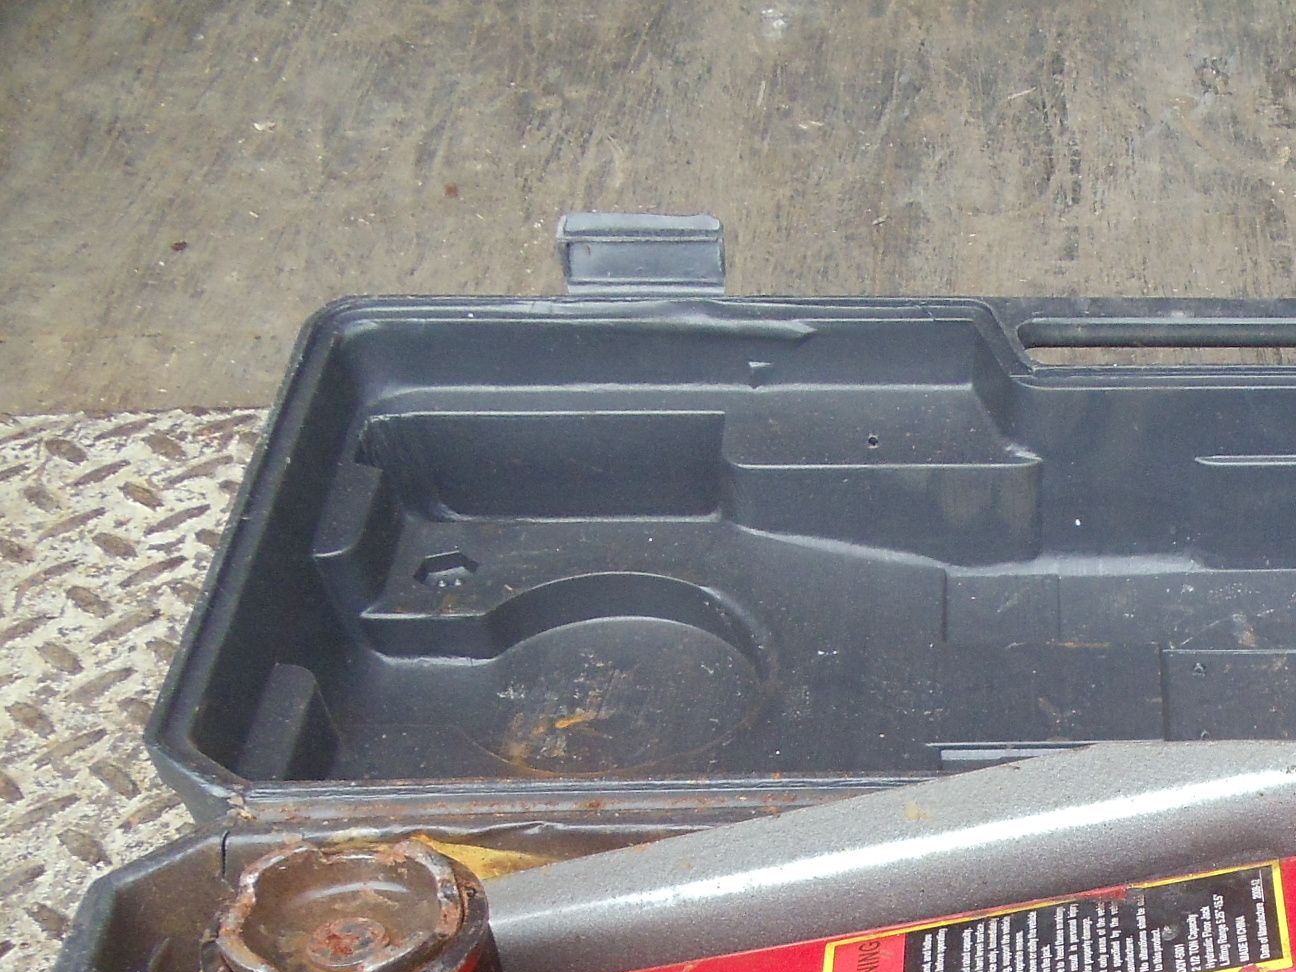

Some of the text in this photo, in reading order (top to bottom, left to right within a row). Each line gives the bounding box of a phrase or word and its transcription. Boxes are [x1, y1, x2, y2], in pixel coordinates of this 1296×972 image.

[1067, 902, 1078, 917] injury
[1136, 907, 1145, 915] be
[1028, 910, 1036, 928] vehicle
[1096, 917, 1105, 927] the
[1110, 917, 1118, 927] the
[1137, 915, 1146, 929] shall
[1186, 913, 1199, 939] Capacity
[1254, 902, 1267, 936] Manufacture
[1028, 928, 1036, 938] the
[1055, 929, 1063, 945] these
[1068, 918, 1079, 943] personal
[1097, 927, 1105, 935] of
[1110, 929, 1121, 938] by
[1199, 905, 1217, 968] Hydraulic Floor Jack
[1216, 923, 1229, 943] Range
[1235, 915, 1249, 961] MADE IN CHINA
[937, 927, 947, 952] operating
[1001, 934, 1009, 944] the
[1137, 930, 1148, 960] alterations
[975, 942, 983, 956] level
[1001, 943, 1012, 966] support
[1083, 939, 1094, 964] property
[1111, 940, 1123, 967] specified
[1188, 940, 1198, 954] TON
[1218, 943, 1232, 966] Lifting
[1259, 943, 1270, 958] Date
[922, 950, 931, 961] and
[935, 953, 944, 971] before
[962, 952, 970, 967] rated
[974, 956, 983, 970] hard
[1041, 957, 1050, 967] the
[1069, 953, 1078, 971] result
[1098, 953, 1109, 968] only
[1152, 951, 1162, 963] this
[1190, 955, 1200, 965] 1/2
[1140, 961, 1149, 972] No
[1154, 963, 1163, 971] to
